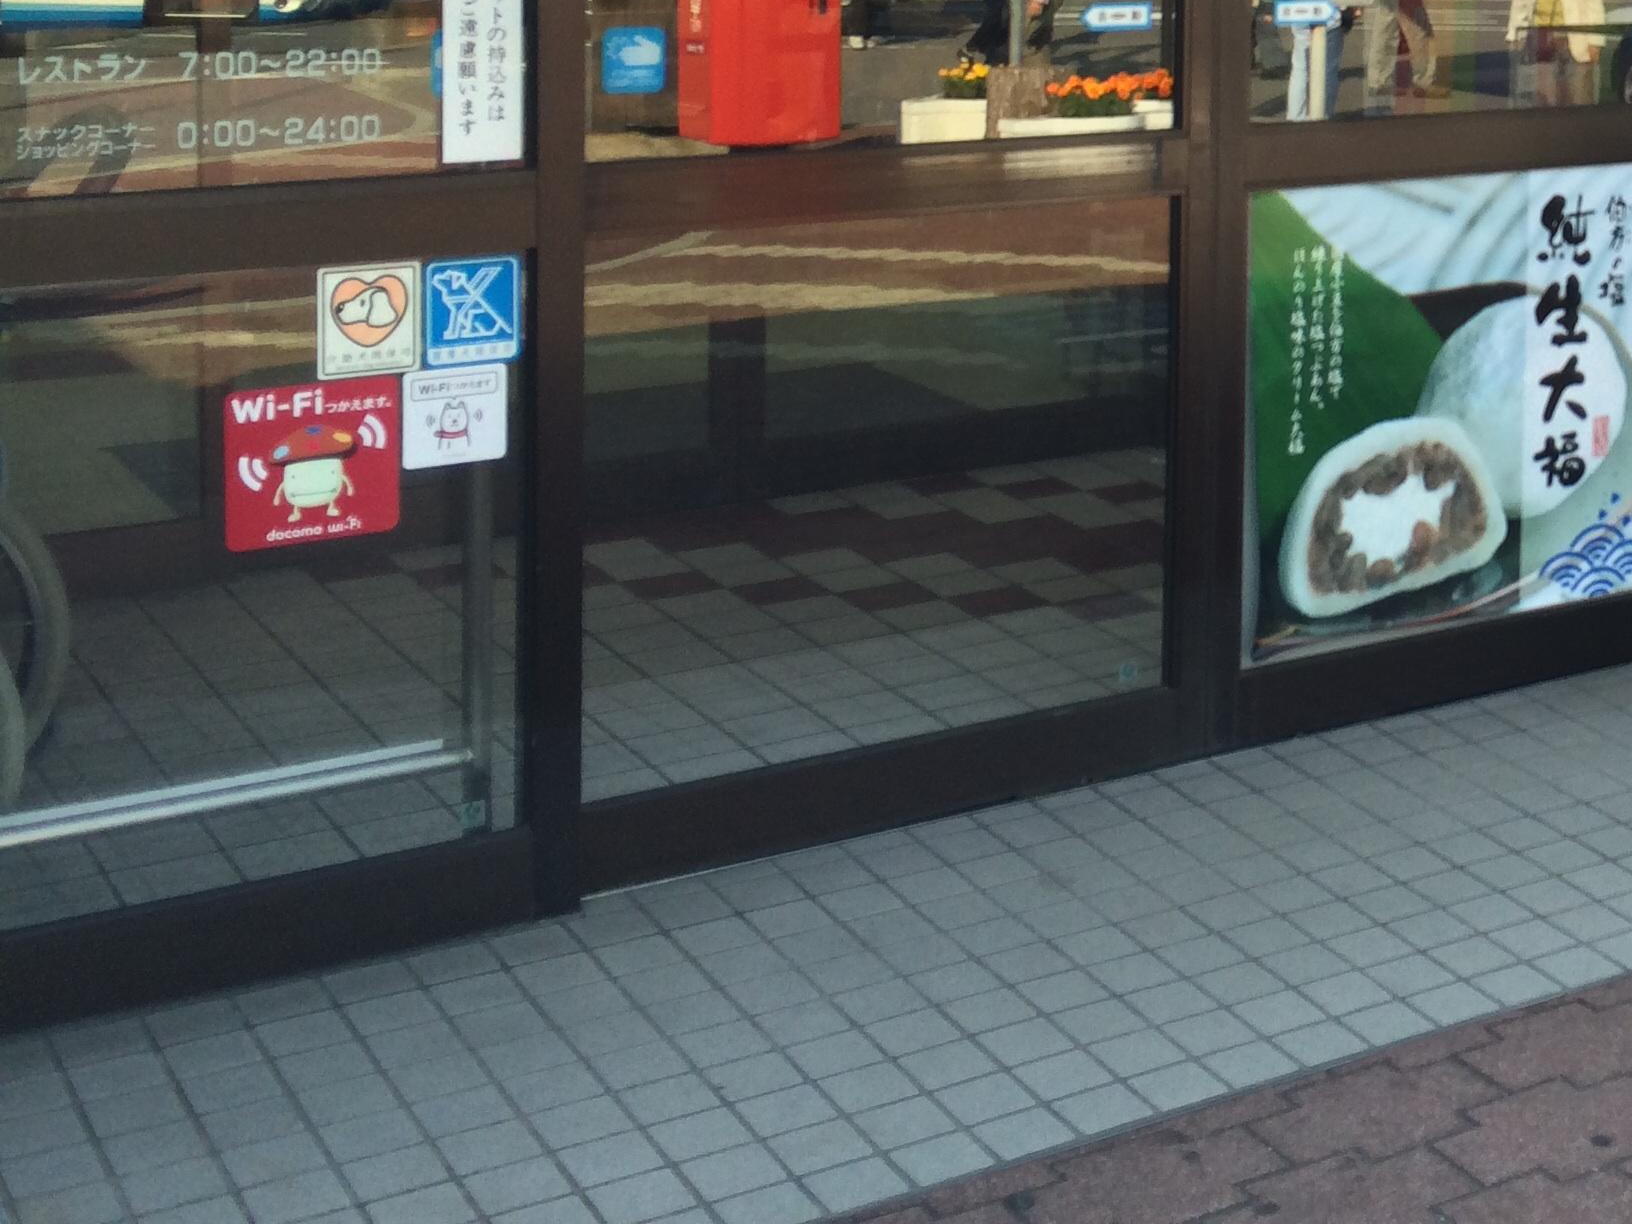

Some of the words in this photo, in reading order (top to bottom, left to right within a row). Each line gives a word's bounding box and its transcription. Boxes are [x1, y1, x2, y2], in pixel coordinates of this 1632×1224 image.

[18, 52, 147, 85] レストラン
[17, 123, 156, 143] スナックコーナー
[1534, 194, 1595, 487] 純生大福
[266, 525, 323, 542] docomo
